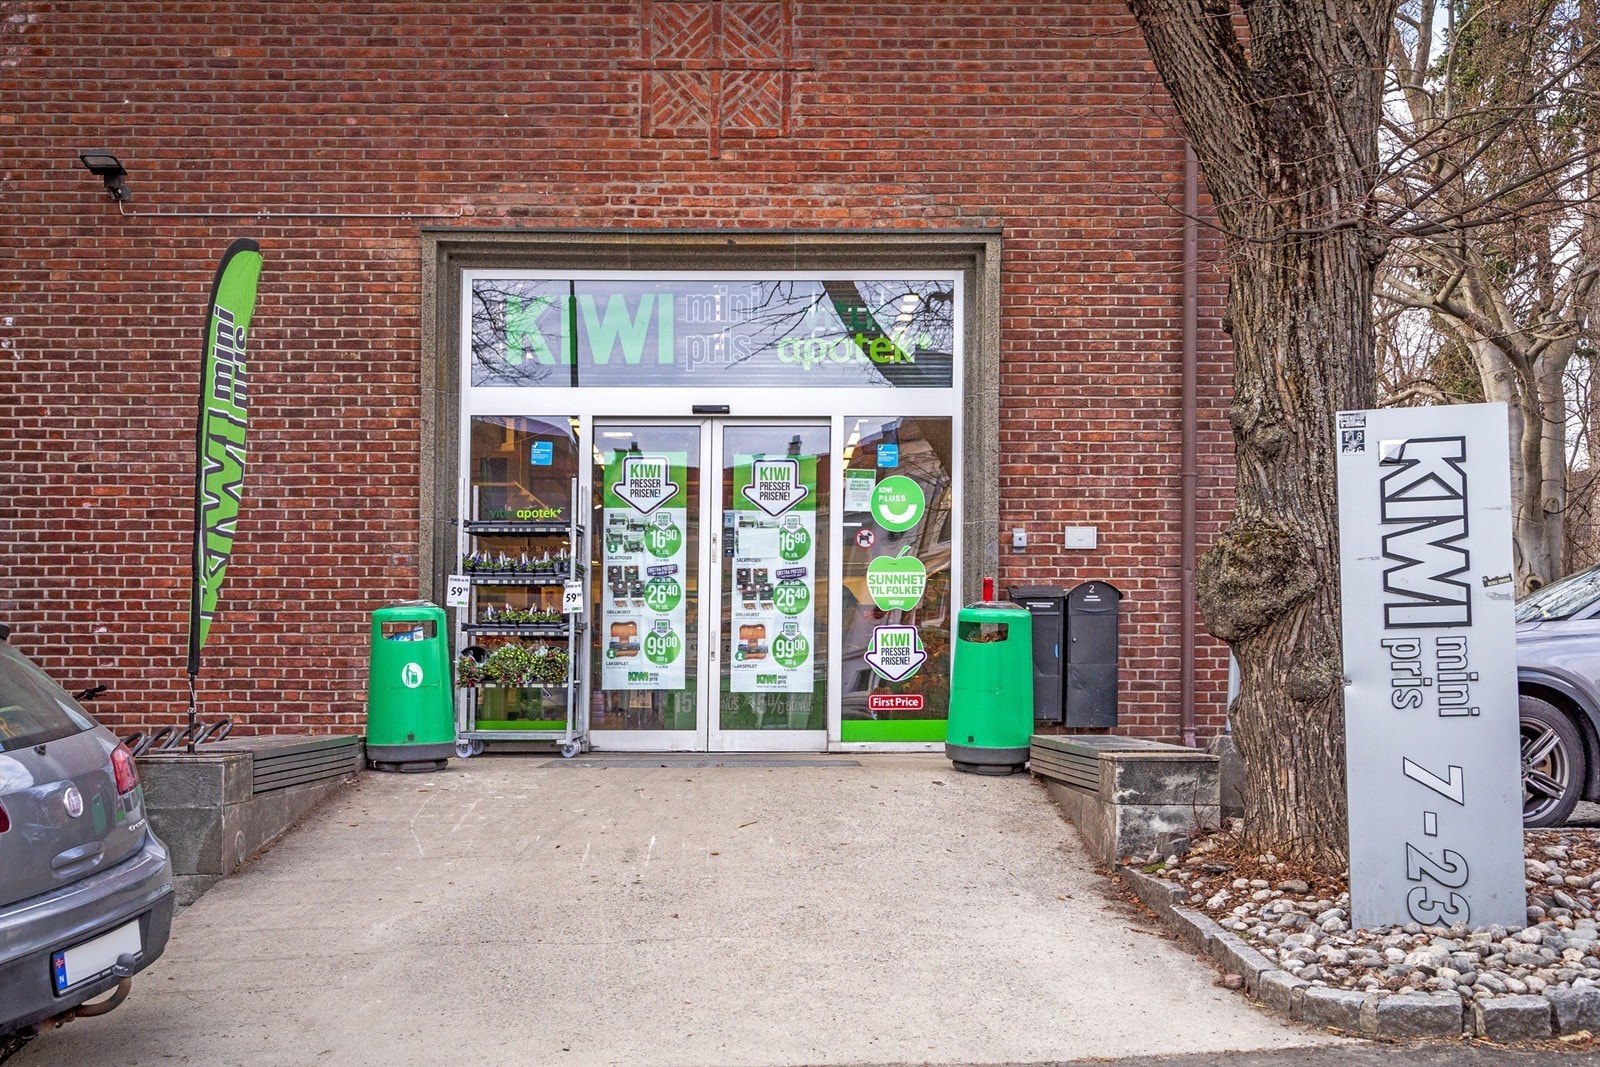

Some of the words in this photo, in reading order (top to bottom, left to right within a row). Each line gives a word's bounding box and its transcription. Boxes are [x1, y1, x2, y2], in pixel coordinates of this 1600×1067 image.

[684, 285, 760, 324] mini
[505, 293, 675, 366] KIWI
[212, 304, 235, 403] mini
[684, 328, 752, 372] pris
[232, 325, 248, 411] pris
[630, 464, 661, 478] KIWI
[759, 467, 791, 481] KIWI
[630, 479, 661, 488] PRESSER
[759, 482, 791, 491] PRESSER
[630, 489, 661, 498] PRISENE!
[759, 492, 791, 501] PRISENE!
[200, 407, 248, 619] KIWI
[1378, 436, 1472, 629] KIWI
[868, 575, 925, 585] SUNNHET
[870, 586, 884, 595] TIL
[886, 586, 924, 595] FOLKET
[1088, 584, 1095, 593] 2
[881, 634, 910, 646] KIWI
[881, 647, 910, 656] PRESSER
[881, 657, 910, 665] PRISENE!
[628, 672, 648, 681] KIWI
[1381, 637, 1433, 710] pris
[1436, 636, 1480, 717] mini
[756, 674, 777, 684] KIWI
[873, 697, 894, 707] First
[895, 697, 919, 707] Price
[59, 975, 65, 984] N
